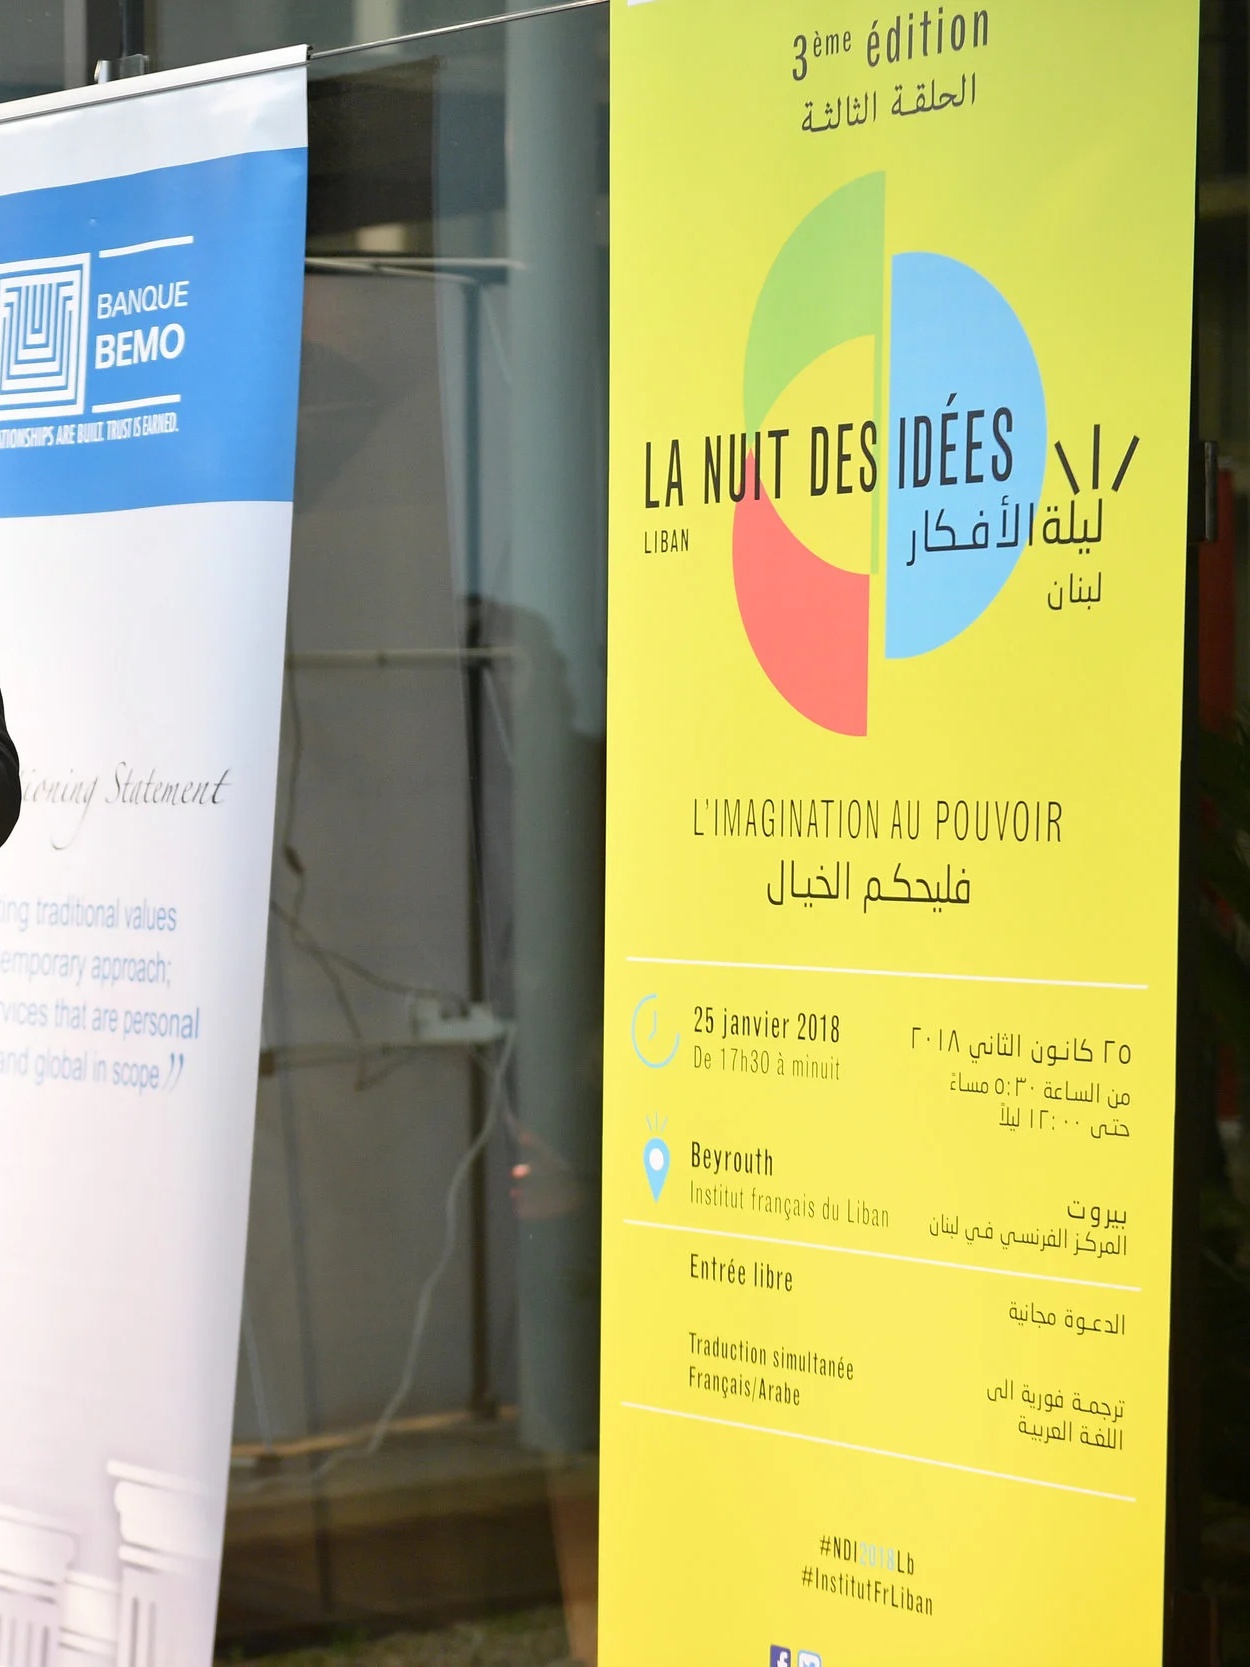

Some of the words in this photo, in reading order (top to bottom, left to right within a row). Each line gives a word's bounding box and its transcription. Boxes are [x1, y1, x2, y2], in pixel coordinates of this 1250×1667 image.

[792, 28, 852, 81] 3ème
[867, 7, 990, 68] édition
[801, 91, 877, 133] الثالثة
[890, 73, 977, 117] الحلقة
[97, 280, 190, 320] BANQUE
[94, 323, 186, 370] BEMO
[56, 423, 76, 446] ARE
[106, 418, 132, 440] TRUST
[133, 416, 142, 437] IS
[143, 412, 179, 436] EARNED.
[645, 439, 684, 508] LA
[704, 429, 789, 505] NUIT
[810, 420, 877, 496] DES
[898, 392, 1014, 489] IDÉES
[644, 528, 689, 554] LIBAN
[907, 494, 1034, 567] الأفكار
[1042, 498, 1103, 555] ليلة
[1047, 571, 1102, 611] لبنان
[104, 761, 232, 805] Statement
[693, 798, 879, 839] L'IMAGINATION
[890, 799, 920, 840] AU
[936, 800, 1062, 842] POUVOIR
[767, 859, 850, 908] الخيال
[863, 863, 971, 914] فليحكم
[36, 893, 121, 930] traditional
[124, 898, 177, 933] values
[91, 952, 172, 990] approach;
[54, 998, 87, 1031] that
[91, 1008, 118, 1033] are
[123, 1007, 200, 1041] personal
[694, 1006, 714, 1034] 25
[722, 1008, 790, 1039] janvier
[797, 1012, 840, 1043] 2018
[694, 1045, 711, 1069] De
[721, 1048, 770, 1074] 17h30
[777, 1052, 785, 1076] à
[792, 1054, 840, 1080] minuit
[969, 1032, 1021, 1064] الثاني
[1031, 1037, 1093, 1066] كانون
[1104, 1040, 1131, 1065] ٢٥
[34, 1049, 87, 1087] global
[92, 1053, 107, 1080] in
[1043, 1081, 1100, 1103] الساعة
[1107, 1089, 1131, 1109] من
[1090, 1119, 1130, 1139] حتى
[691, 1141, 773, 1176] Beyrouth
[690, 1180, 744, 1210] Institut
[751, 1187, 815, 1220] français
[822, 1196, 839, 1222] du
[847, 1198, 889, 1228] Liban
[1067, 1200, 1127, 1230] بيروت
[929, 1214, 959, 1239] لبنان
[965, 1221, 993, 1245] في
[1000, 1228, 1067, 1252] الفرنسي
[1073, 1231, 1127, 1258] المركز
[690, 1253, 746, 1286] Entrée
[754, 1261, 793, 1292] libre
[1009, 1301, 1056, 1329] مجانية
[1064, 1309, 1125, 1336] الدعوة
[689, 1332, 767, 1366] Traduction
[773, 1347, 854, 1380] simultanée
[689, 1366, 800, 1406] Français/Arabe
[1021, 1384, 1064, 1412] فورية
[1072, 1392, 1125, 1423] ترجمة
[1018, 1415, 1072, 1444] العربية
[1080, 1425, 1123, 1451] اللغة
[819, 1534, 914, 1576] #NDI2018Lb
[801, 1565, 933, 1616] #InstitutFrLiban
